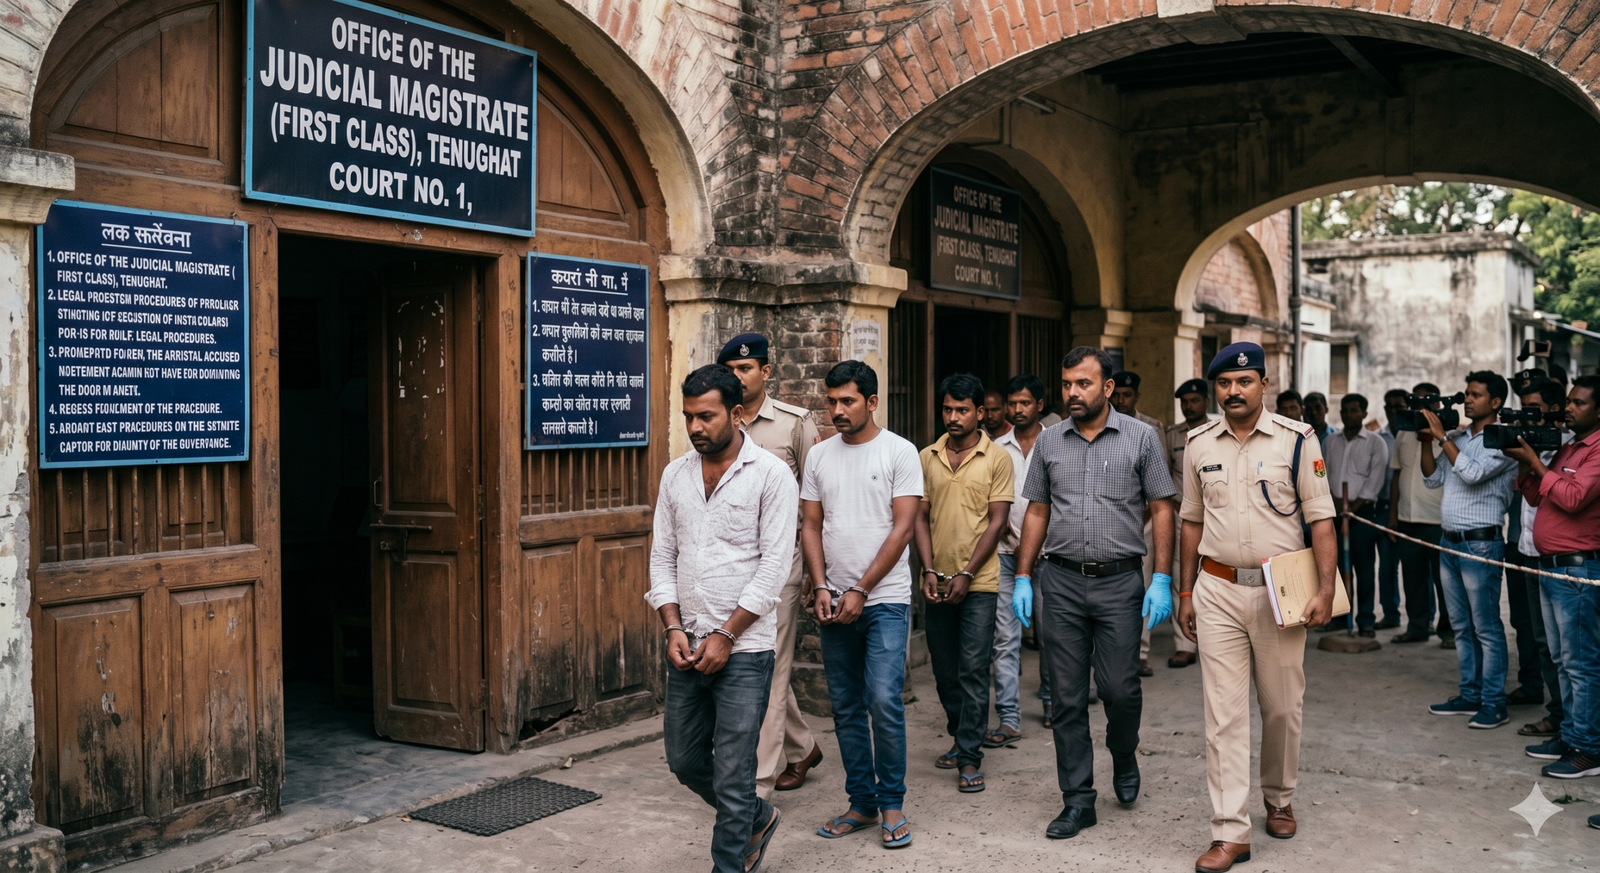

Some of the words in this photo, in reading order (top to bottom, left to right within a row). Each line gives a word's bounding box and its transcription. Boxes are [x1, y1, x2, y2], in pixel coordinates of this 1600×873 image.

[332, 18, 404, 64] OFFICE
[410, 38, 434, 70] OF
[439, 46, 475, 82] THE
[260, 46, 382, 109] JUDICIAL
[390, 75, 528, 141] MAGISTRATE
[271, 102, 340, 144] (FIRST
[347, 118, 422, 166] CLASS),
[428, 133, 521, 178] TENUGHAT
[330, 162, 408, 200] COURT
[414, 176, 449, 206] NO.
[456, 182, 472, 216] 1,
[954, 186, 977, 207] OFFICE
[979, 192, 987, 209] OF
[989, 194, 1002, 213] THE
[934, 205, 970, 234] JUDICIAL
[972, 214, 1018, 244] MAGISTRATE
[937, 235, 958, 256] (FIRST
[960, 239, 984, 265] CLASS),
[985, 245, 1016, 267] TENUGHAT
[47, 251, 55, 262] 1.
[57, 251, 92, 265] OFFICE
[94, 254, 106, 266] OF
[109, 255, 128, 268] THE
[131, 257, 173, 272] JUDICIAL
[176, 261, 230, 276] MAGISTRATE
[57, 270, 83, 283] FIRST
[85, 273, 119, 288] CLASS),
[120, 274, 167, 289] TENUGHAT.
[955, 265, 979, 283] COURT
[981, 269, 993, 286] NO.
[48, 290, 55, 300] 2.
[58, 290, 85, 302] LEGAL
[134, 294, 186, 307] PROCEDURES
[188, 297, 198, 308] OF
[533, 300, 540, 312] 1.
[163, 314, 172, 324] OF
[91, 329, 107, 340] FOR
[136, 330, 162, 342] LEGAL
[164, 331, 216, 344] PROCEDURES.
[533, 325, 540, 336] 2.
[49, 346, 57, 358] 3.
[147, 349, 163, 360] THE
[165, 350, 202, 361] ARRISTAL
[204, 351, 240, 362] ACCUSED
[162, 368, 181, 378] HAVE
[533, 374, 540, 386] 3.
[59, 384, 76, 396] THE
[78, 384, 101, 396] DOOR
[49, 404, 57, 414] 4.
[145, 403, 155, 414] OF
[157, 403, 173, 414] THE
[175, 403, 222, 414] PRACEDURE.
[50, 423, 58, 434] 5.
[96, 422, 117, 433] EAST
[120, 421, 172, 433] PRACEDURES
[175, 421, 186, 432] ON
[188, 421, 204, 431] THE
[60, 442, 93, 453] CAPTOR
[95, 441, 111, 452] FOR
[113, 440, 148, 451] DIAUNTY
[150, 440, 160, 450] OF
[162, 439, 178, 449] THE
